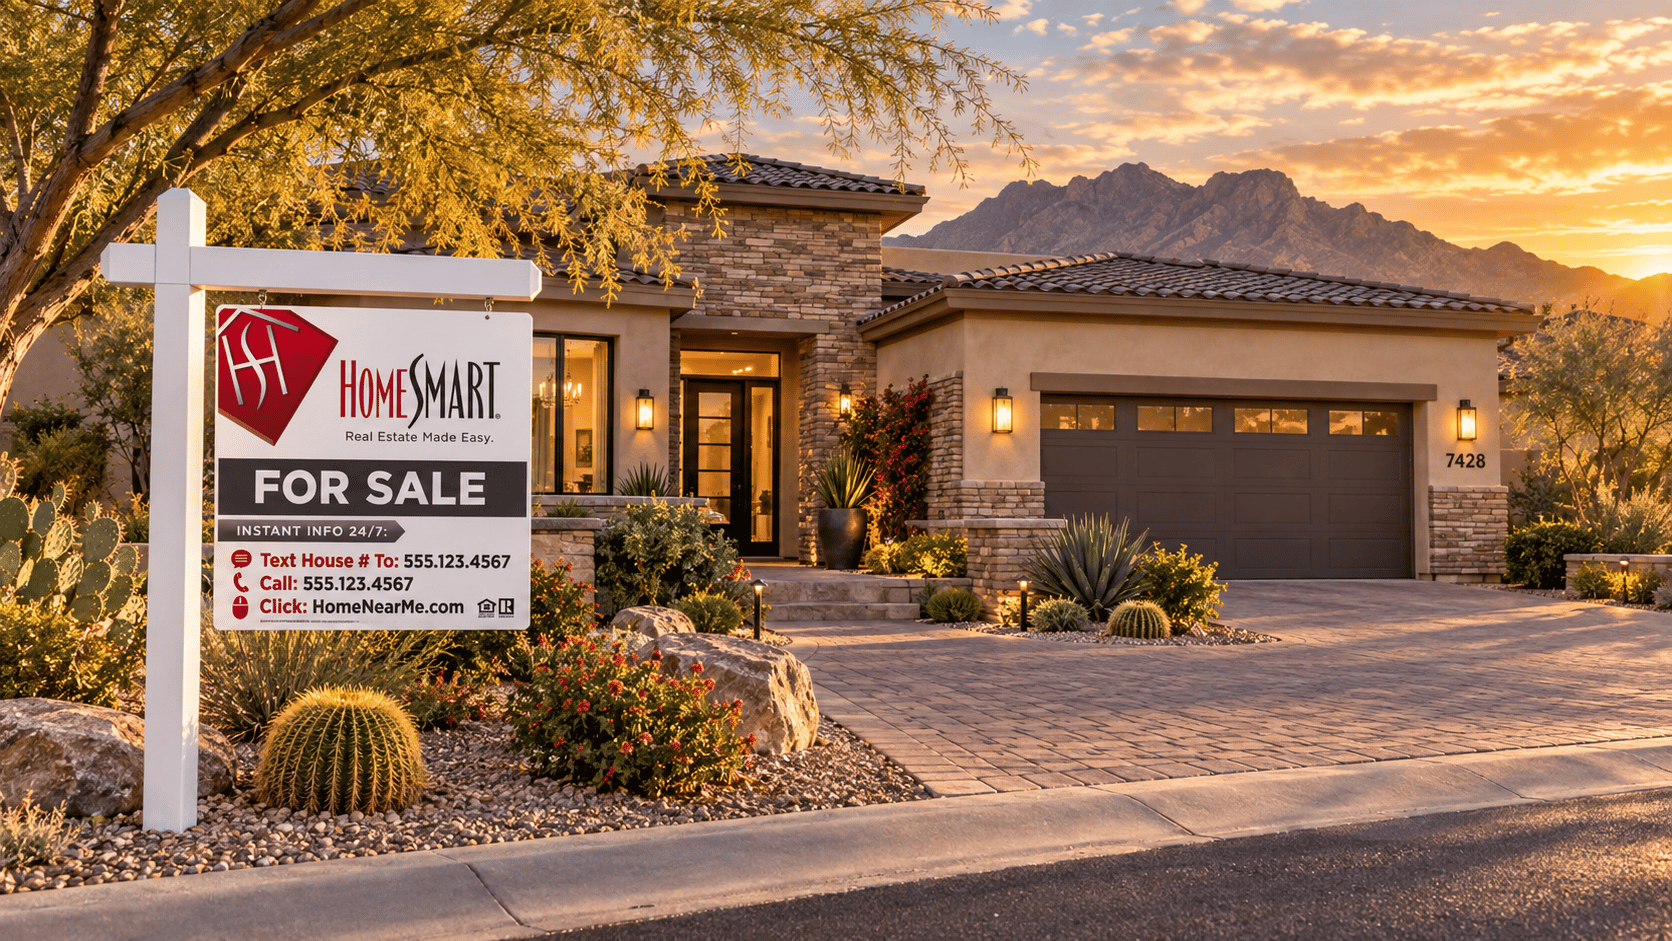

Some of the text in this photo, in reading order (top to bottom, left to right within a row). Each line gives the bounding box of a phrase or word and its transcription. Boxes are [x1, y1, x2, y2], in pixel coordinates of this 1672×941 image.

[345, 431, 494, 445] Real Estate Made Easy.
[1446, 453, 1486, 468] 7428
[255, 469, 486, 505] FOR SALE
[237, 525, 388, 538] INSTANT INFO 24/7:
[260, 552, 511, 569] Text House # To: 555.123.4567
[260, 575, 414, 591] Call: 555.123.4567
[260, 598, 464, 614] Click: HomeNearMe.com
